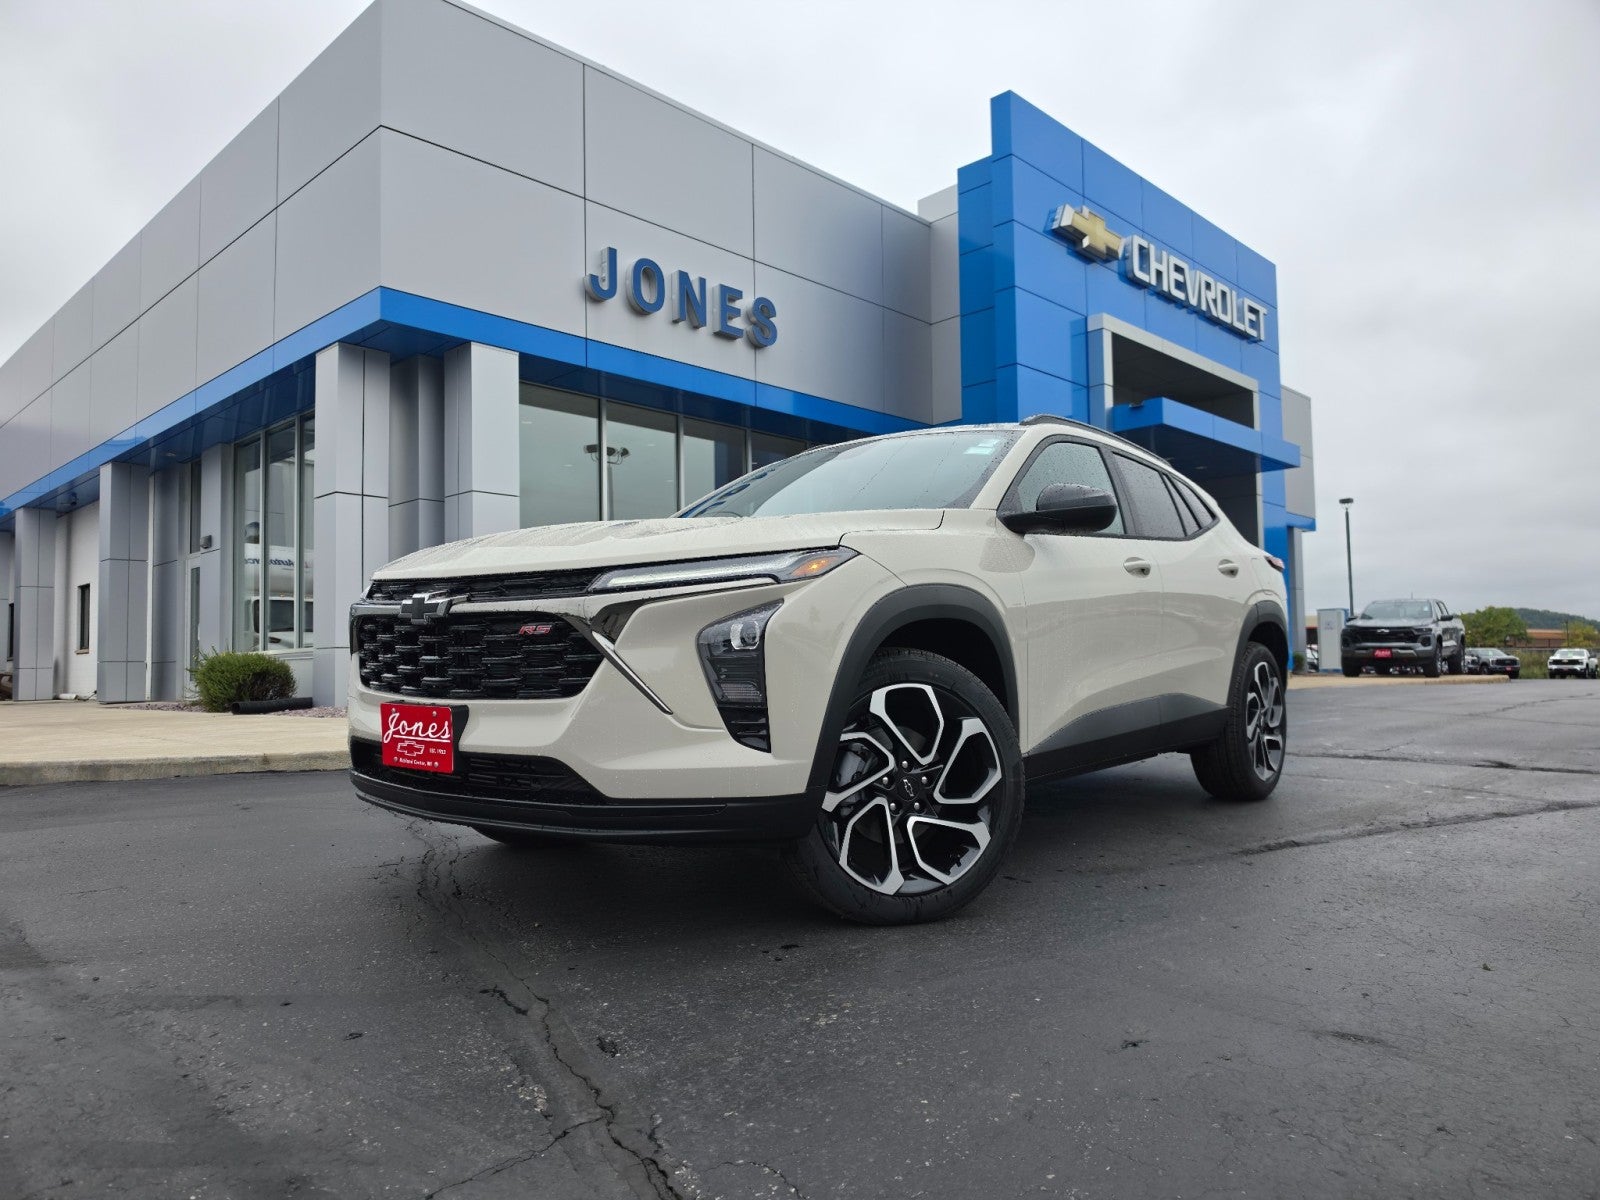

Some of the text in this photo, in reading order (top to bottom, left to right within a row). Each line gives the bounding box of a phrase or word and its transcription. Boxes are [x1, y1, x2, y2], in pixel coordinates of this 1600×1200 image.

[584, 246, 778, 349] JONES
[1127, 234, 1267, 342] CHEVROLET
[519, 624, 552, 635] RS
[383, 713, 451, 743] Jones
